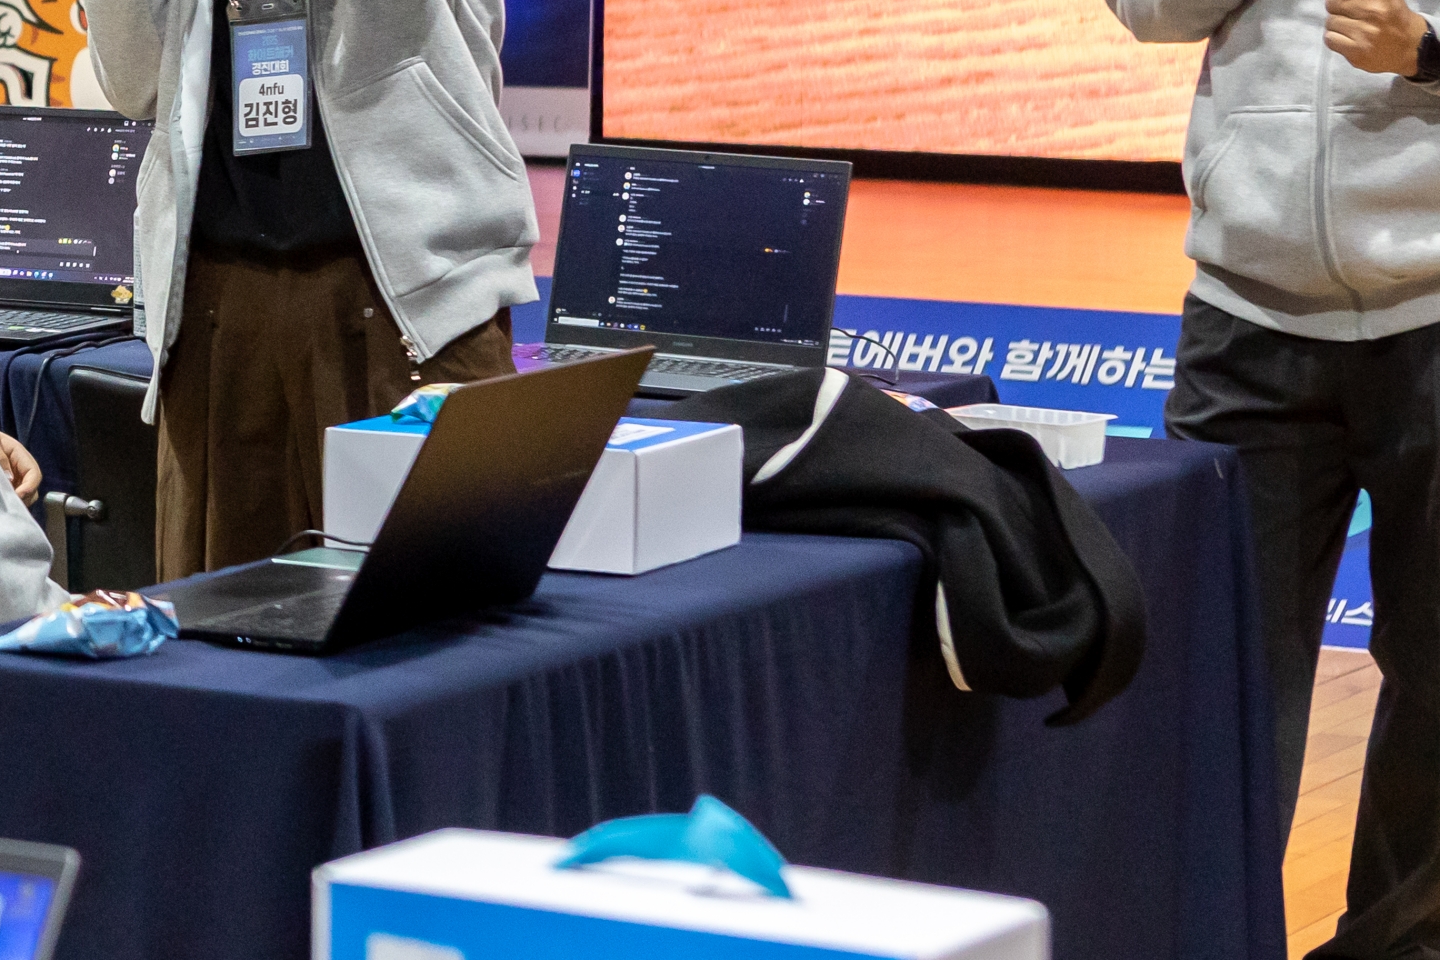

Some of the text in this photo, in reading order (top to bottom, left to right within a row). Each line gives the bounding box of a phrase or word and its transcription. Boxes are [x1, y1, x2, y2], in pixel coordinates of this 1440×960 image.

[252, 60, 290, 76] 경진대회
[259, 82, 285, 96] 4nfu
[243, 98, 298, 129] 김진형
[1000, 339, 1176, 390] 함께하는
